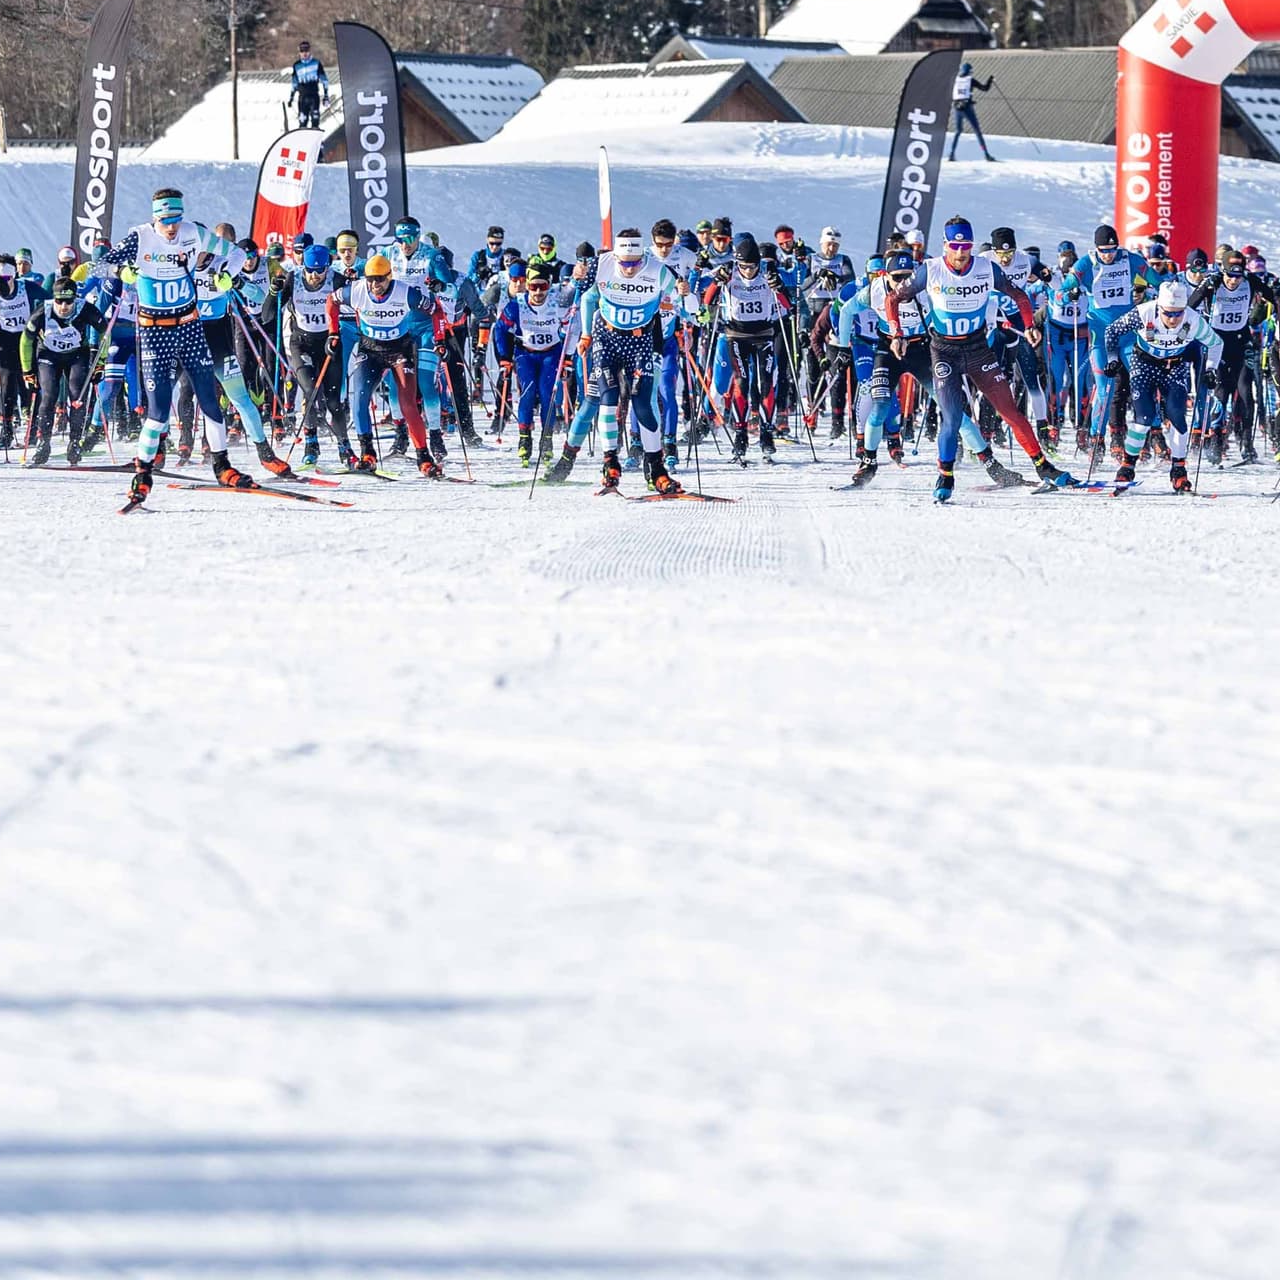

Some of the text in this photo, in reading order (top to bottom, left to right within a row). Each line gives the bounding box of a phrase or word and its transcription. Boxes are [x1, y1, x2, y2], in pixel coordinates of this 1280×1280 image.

[1167, 8, 1199, 40] SAVOIE
[77, 63, 116, 255] ekosport
[894, 108, 937, 233] osport
[1122, 132, 1152, 260] avoie
[1155, 132, 1174, 253] épartement
[144, 247, 196, 264] ekosport
[153, 281, 190, 303] 104
[599, 281, 655, 294] ekosport
[733, 283, 766, 293] eosport
[933, 282, 989, 297] ekosport
[1101, 287, 1124, 299] 132
[361, 309, 405, 319] kosport
[609, 305, 645, 325] 105
[739, 301, 763, 314] 133
[5, 317, 25, 327] 214
[303, 313, 326, 324] 141
[1220, 312, 1242, 324] 135
[945, 316, 981, 337] 101
[530, 334, 553, 345] 138
